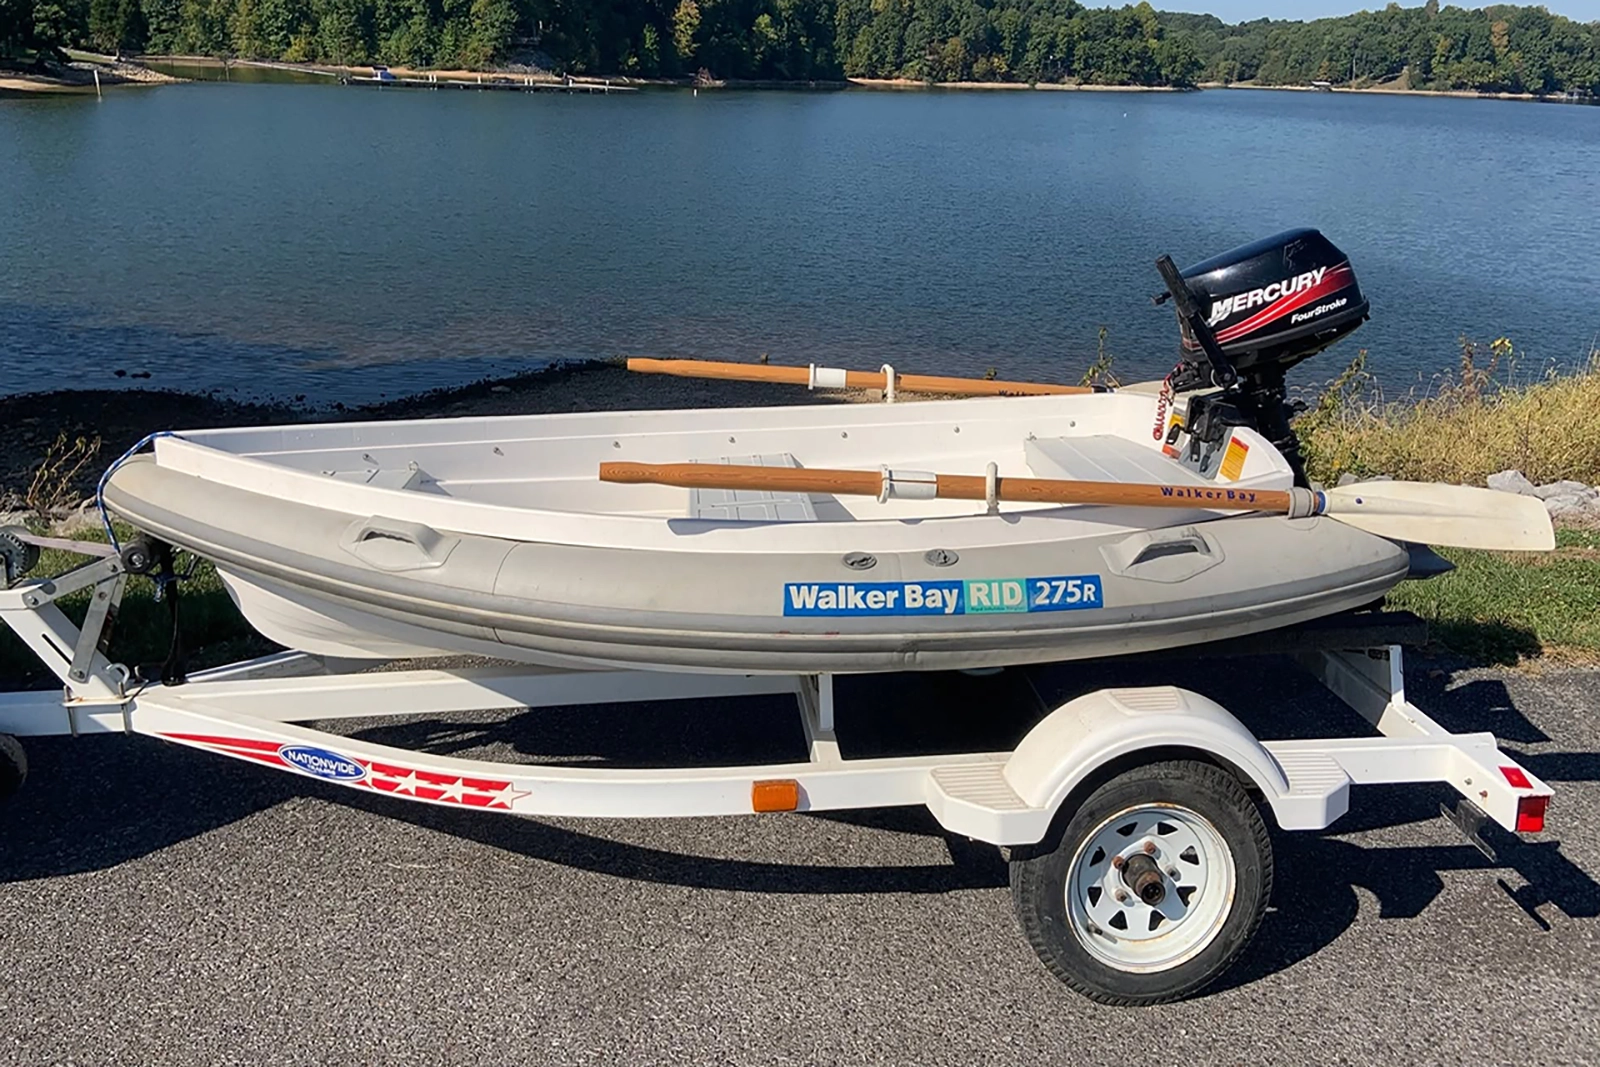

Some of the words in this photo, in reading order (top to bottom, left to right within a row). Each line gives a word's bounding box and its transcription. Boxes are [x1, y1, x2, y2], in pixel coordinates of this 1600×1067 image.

[1207, 266, 1327, 327] MERCURY
[1291, 298, 1347, 324] FourStroke
[1161, 487, 1222, 498] Walker
[1227, 490, 1256, 502] Bay
[789, 585, 898, 609] Walker
[904, 584, 959, 613] Bay
[969, 581, 1023, 607] RID
[1035, 580, 1097, 605] 275R
[287, 750, 356, 775] NATIONWIDE
